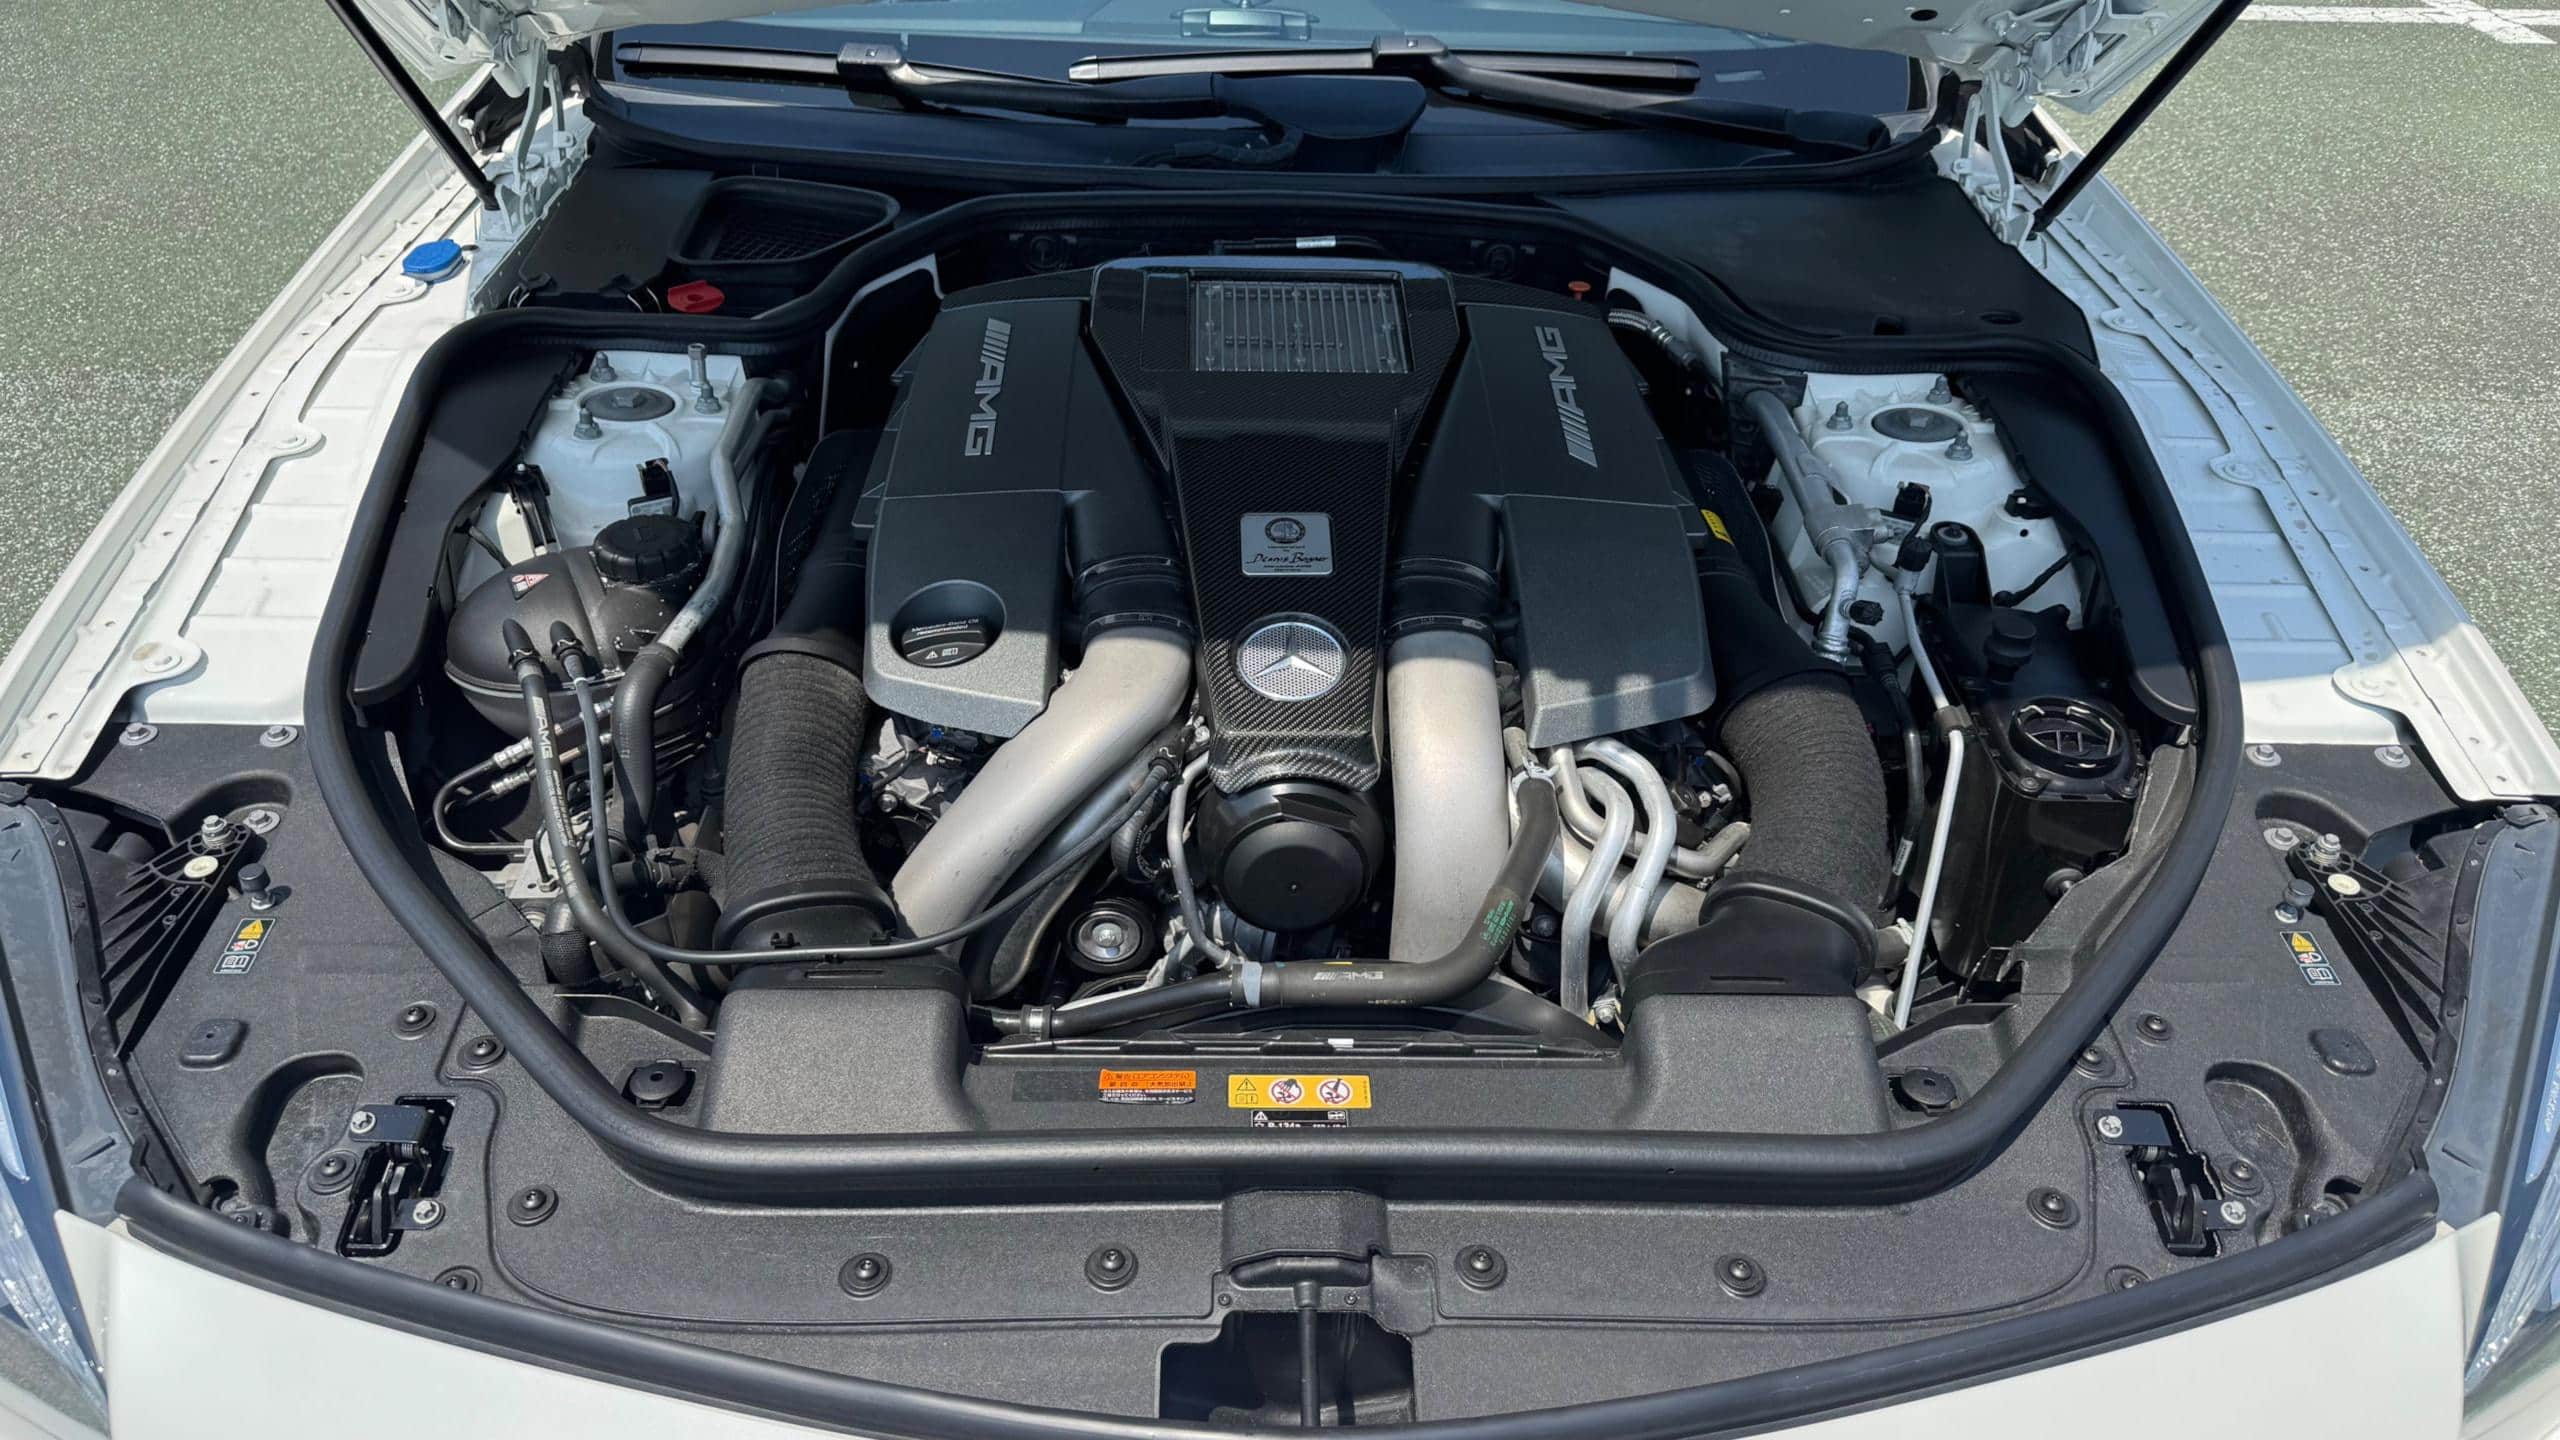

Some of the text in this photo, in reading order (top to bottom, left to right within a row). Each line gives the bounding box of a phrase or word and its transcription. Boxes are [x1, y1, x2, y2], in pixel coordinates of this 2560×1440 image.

[965, 354, 1005, 456] AMG
[1535, 326, 1586, 421] AMG
[534, 714, 553, 760] AMG
[1338, 970, 1384, 981] AMG
